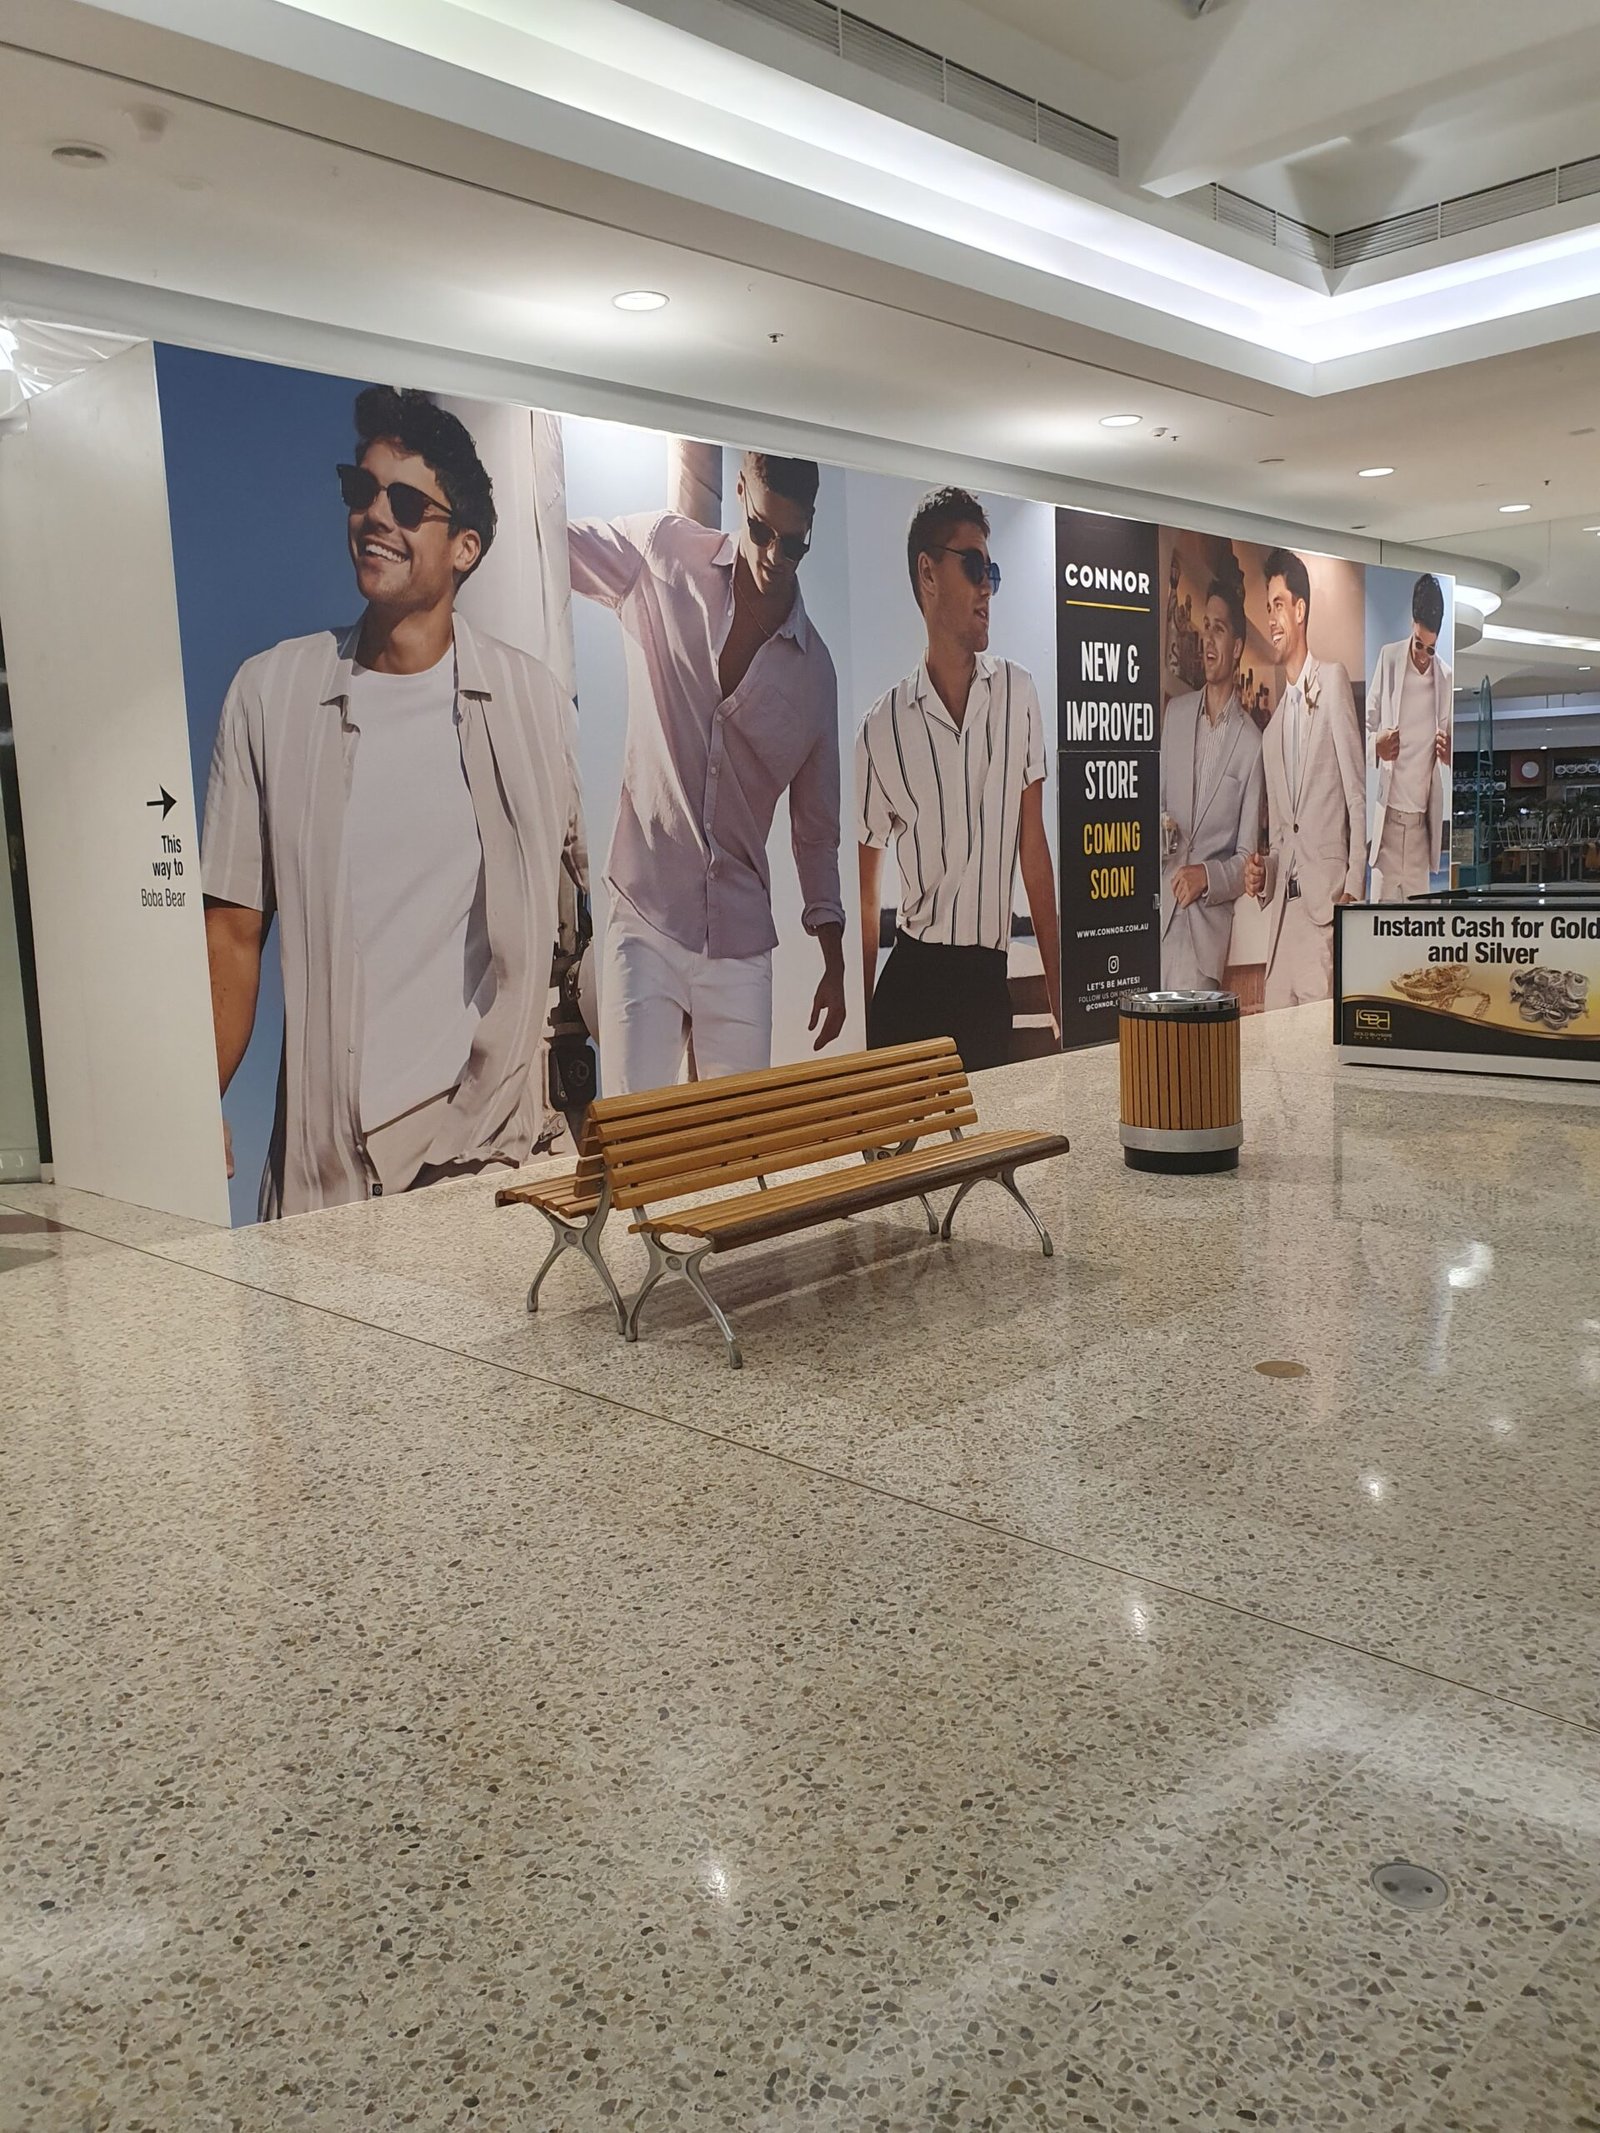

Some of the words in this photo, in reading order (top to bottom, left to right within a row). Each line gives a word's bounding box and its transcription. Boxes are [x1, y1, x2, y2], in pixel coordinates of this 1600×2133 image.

[1065, 563, 1150, 595] CONNOR
[1081, 641, 1121, 682] NEW
[1127, 645, 1140, 683] &
[1066, 701, 1154, 741] IMPROVED
[1085, 760, 1138, 800] STORE
[161, 834, 182, 853] This
[1083, 821, 1141, 855] COMING
[152, 860, 171, 880] way
[173, 858, 184, 876] to
[1090, 866, 1135, 900] SOON!
[141, 887, 163, 907] Boba
[165, 887, 186, 907] Bear
[1076, 923, 1149, 939] WWW.CONNOR.COM.AU
[1373, 915, 1445, 937] Instant
[1451, 915, 1504, 938] Cash
[1511, 915, 1544, 939] for
[1550, 916, 1600, 940] Gold
[1428, 942, 1468, 963] and
[1475, 942, 1539, 965] Silver
[1087, 981, 1105, 991] LET'S
[1106, 980, 1115, 988] BE
[1116, 976, 1140, 987] MATES!
[1079, 994, 1100, 1003] FOLLOW
[1110, 990, 1118, 998] ON
